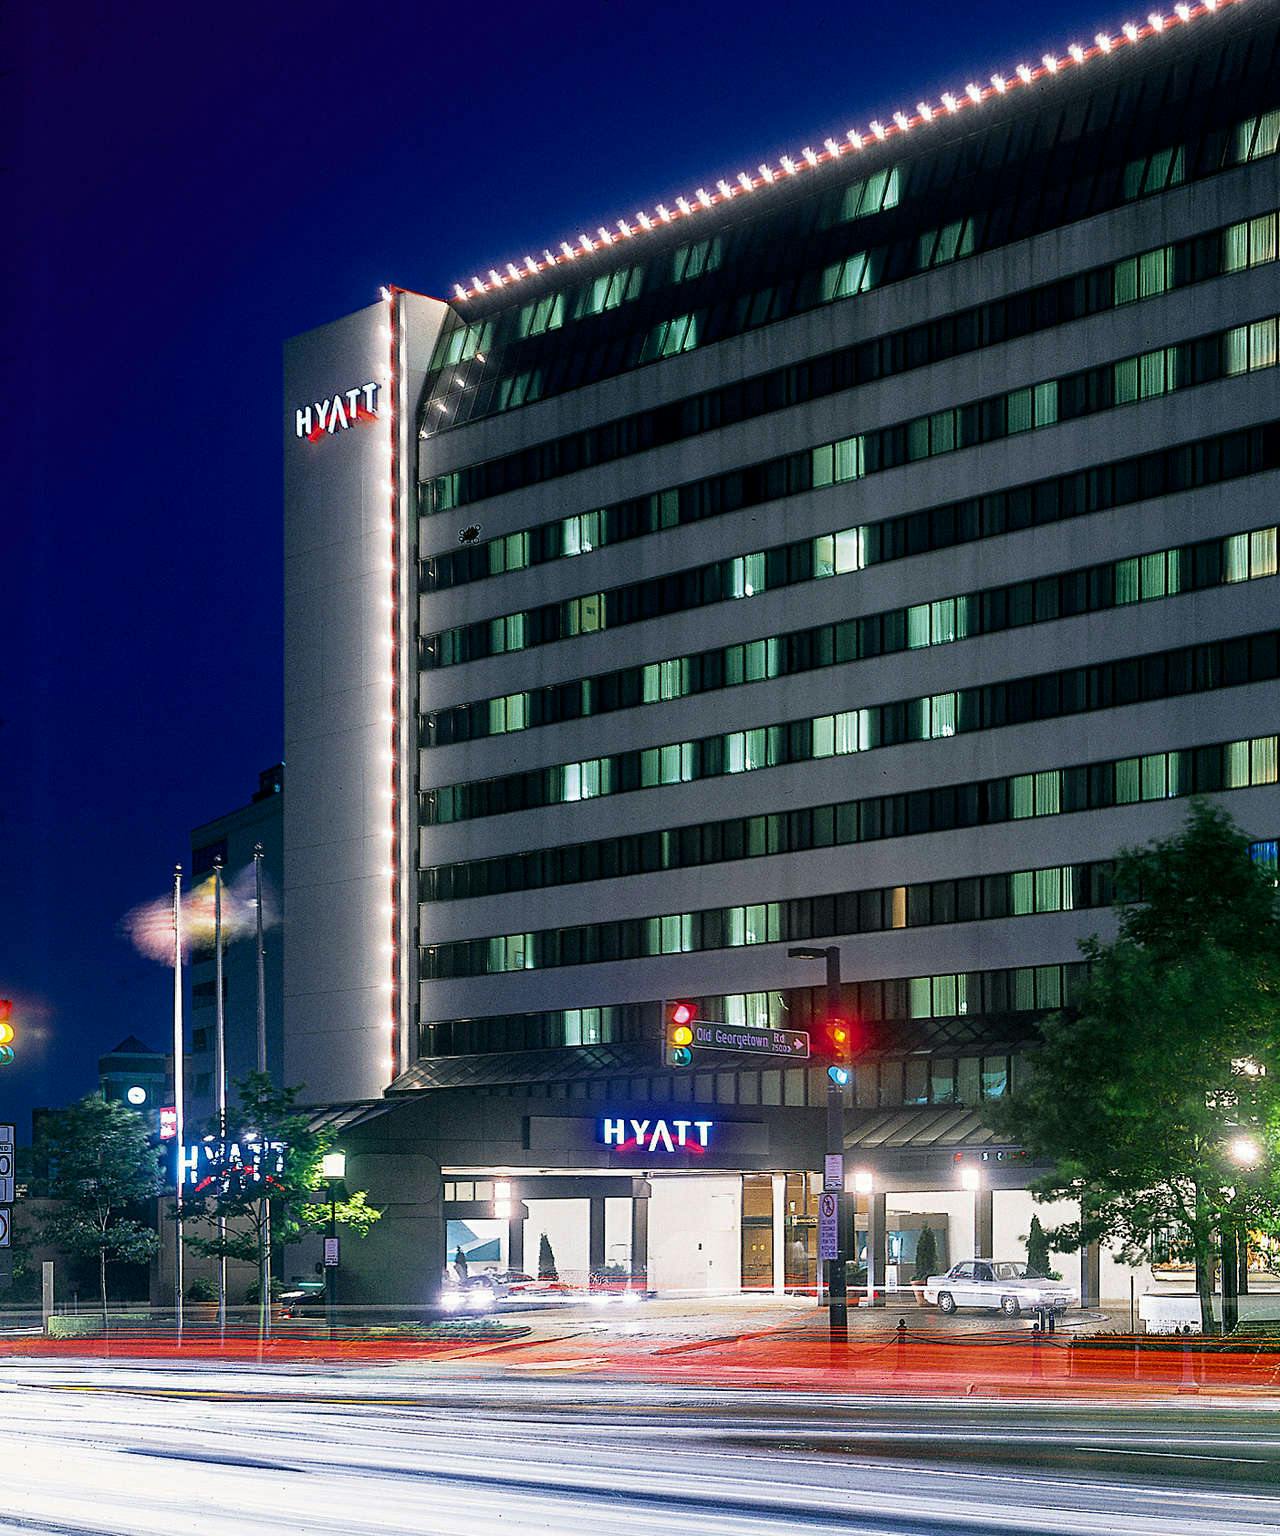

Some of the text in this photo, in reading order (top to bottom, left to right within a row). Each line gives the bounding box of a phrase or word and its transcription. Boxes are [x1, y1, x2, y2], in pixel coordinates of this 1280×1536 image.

[296, 382, 377, 438] HYATT
[696, 1027, 785, 1048] Old Georgetown Rd
[603, 1118, 713, 1153] HYATT
